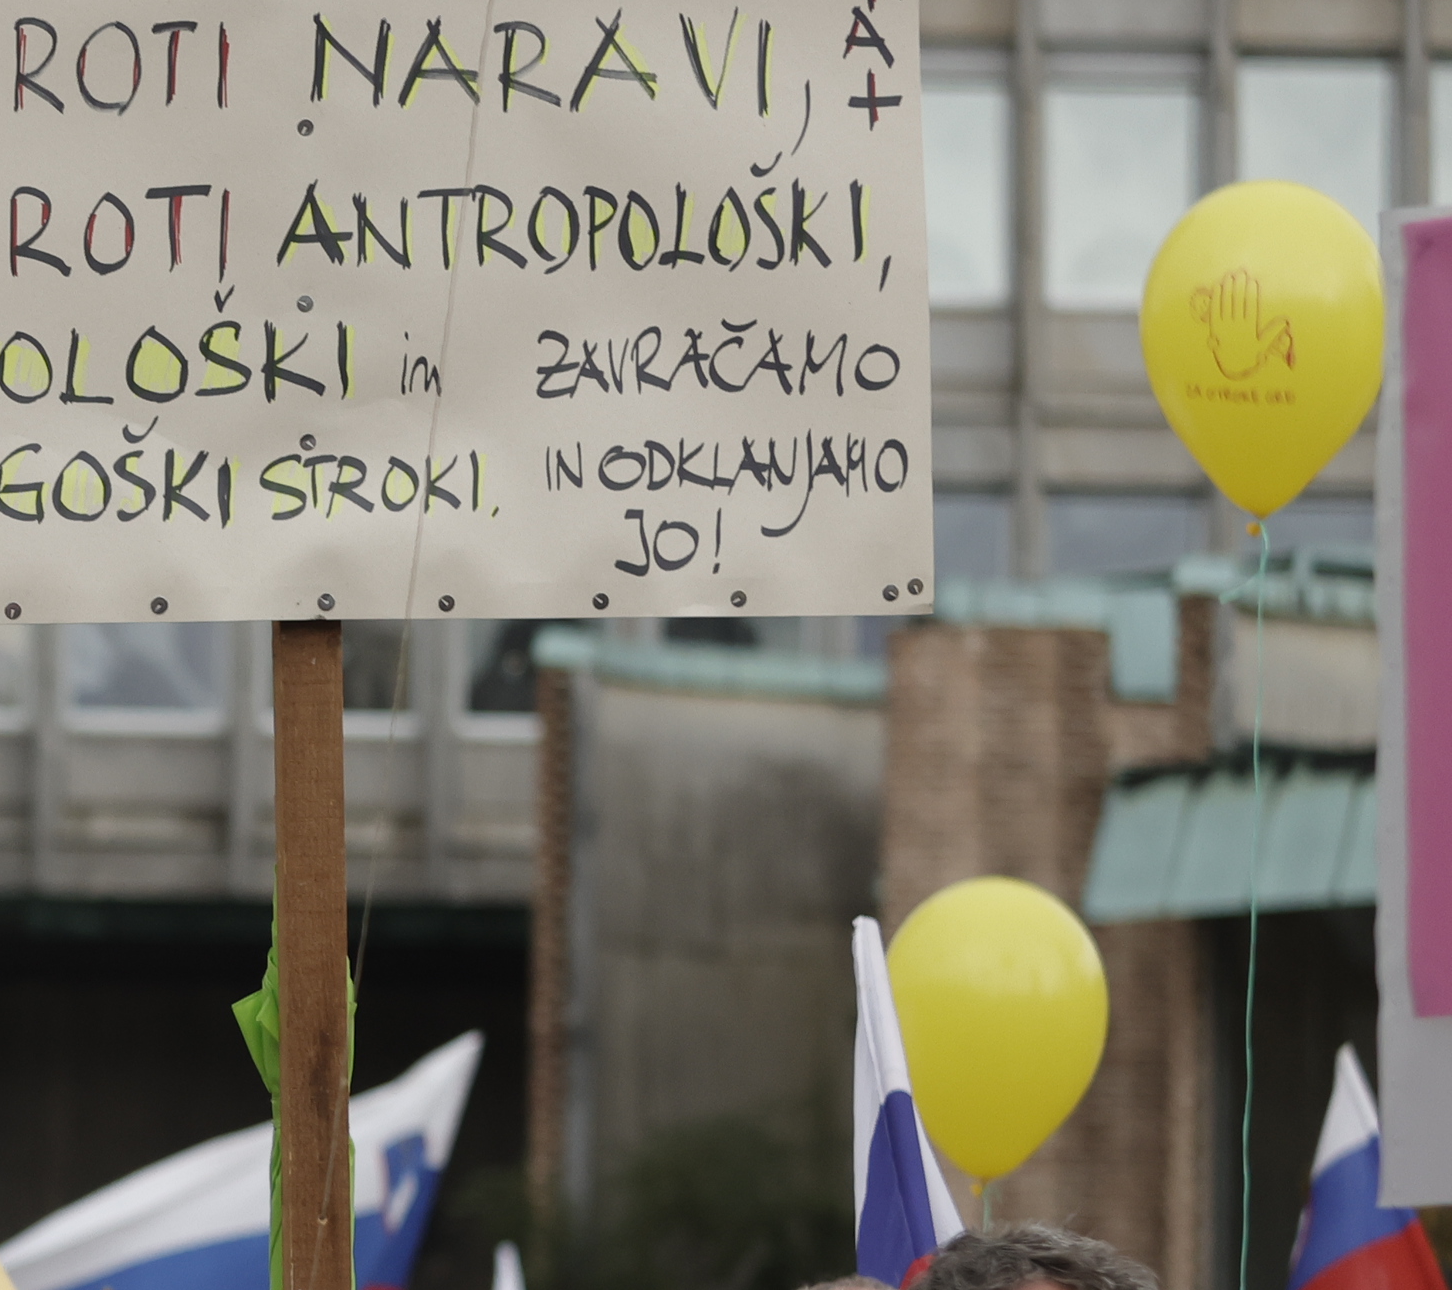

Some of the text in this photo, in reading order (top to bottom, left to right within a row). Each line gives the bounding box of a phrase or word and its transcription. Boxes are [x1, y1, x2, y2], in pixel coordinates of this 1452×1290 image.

[310, 5, 811, 155] NARAVI,
[278, 151, 892, 292] ANTROPOLOŠKI,
[537, 318, 900, 398] ZAVRAČAMO
[546, 428, 908, 537] IN ODKLANJAMO
[614, 507, 722, 577] JO!
